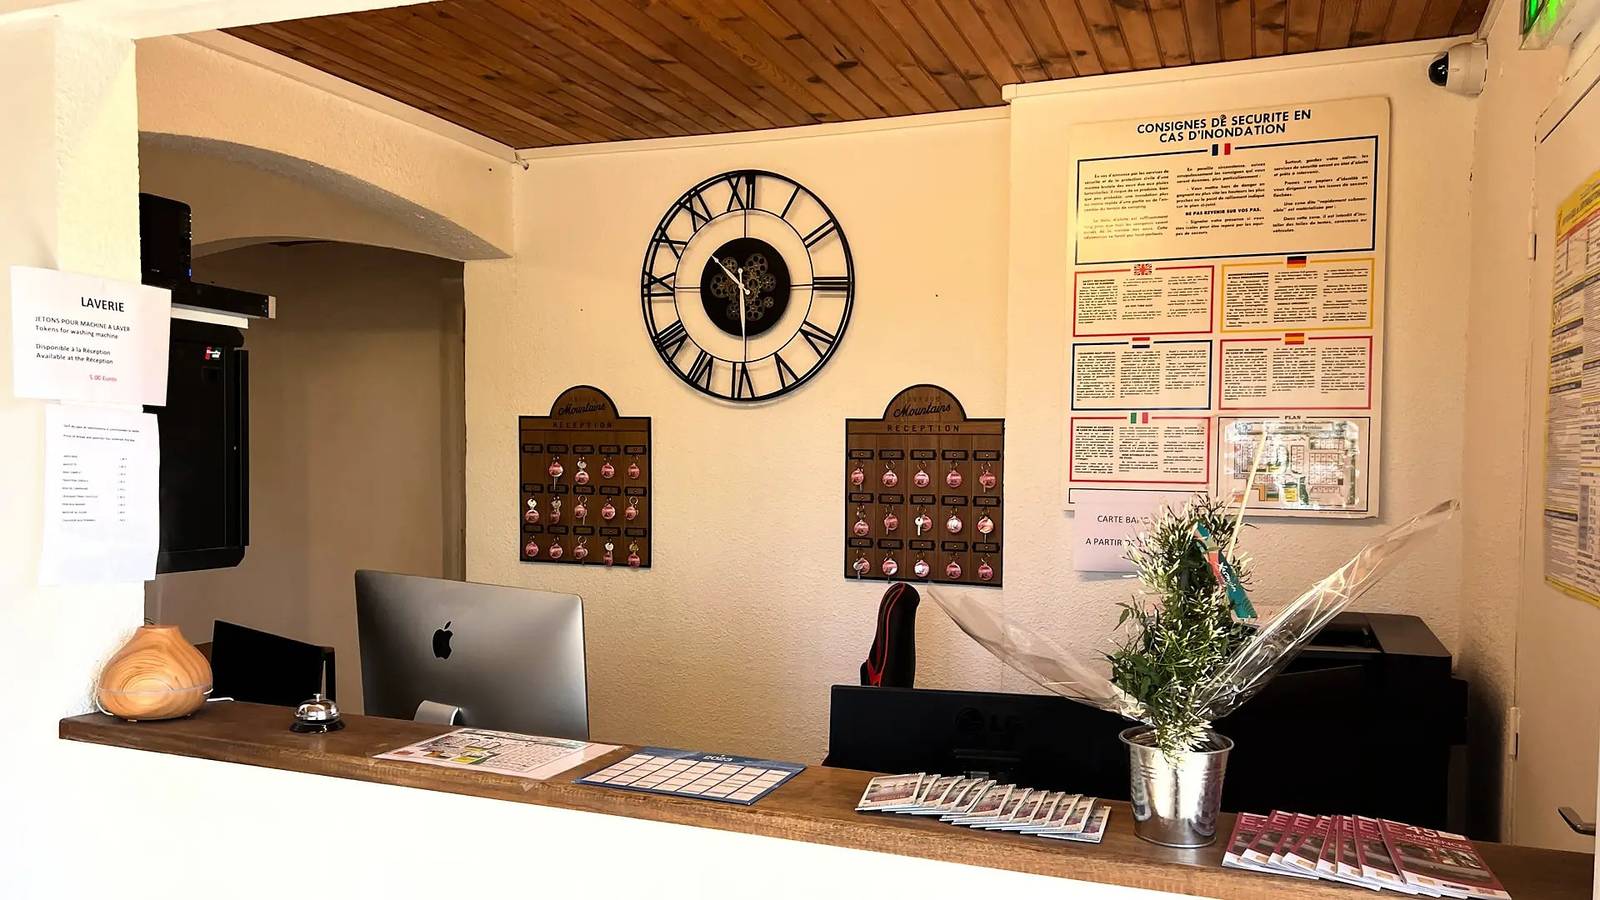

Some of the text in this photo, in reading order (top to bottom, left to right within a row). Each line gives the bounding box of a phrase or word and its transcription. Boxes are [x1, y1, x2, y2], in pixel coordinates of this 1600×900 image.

[1137, 119, 1206, 134] CONSIGNES
[1231, 111, 1290, 126] SECURITE
[1293, 109, 1312, 121] EN
[1159, 123, 1286, 143] CAS D'INONDATION
[81, 297, 125, 312] LAVERIE
[61, 318, 79, 326] POUR
[80, 321, 107, 329] MACHINE
[70, 329, 94, 338] washing
[35, 344, 69, 352] Disponible
[894, 402, 951, 418] Mountains
[887, 424, 960, 432] RECEPTION
